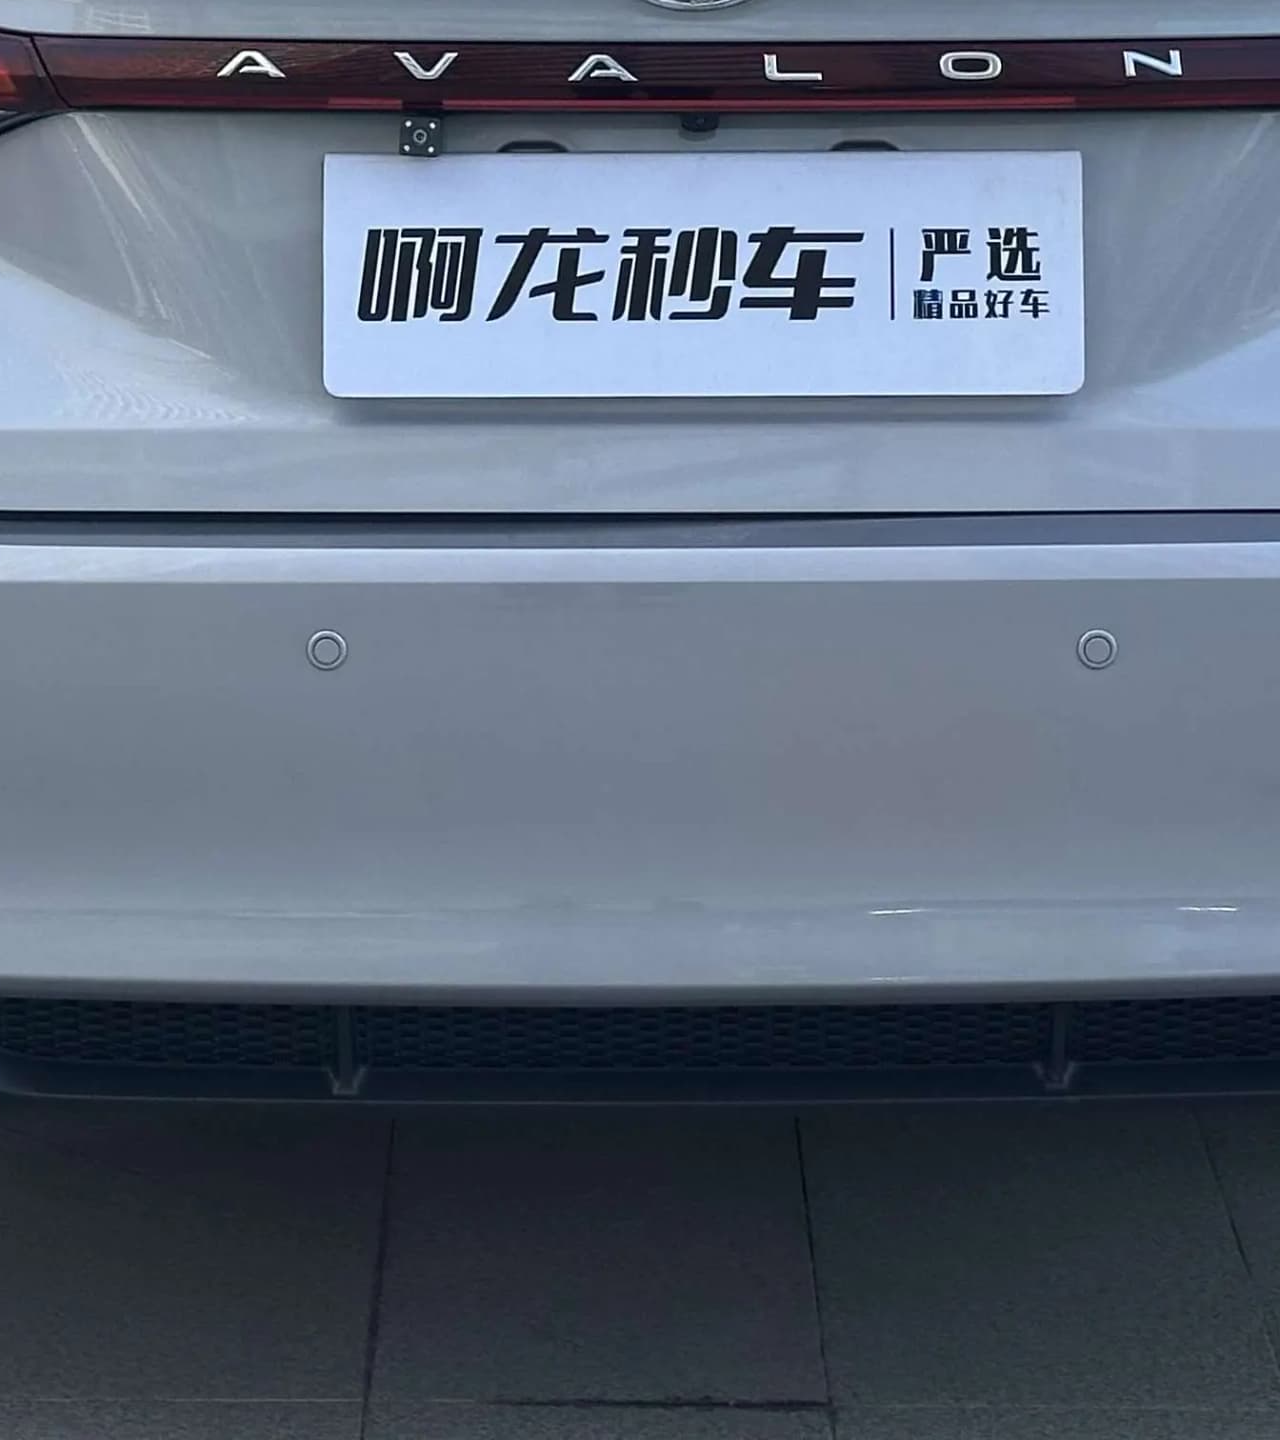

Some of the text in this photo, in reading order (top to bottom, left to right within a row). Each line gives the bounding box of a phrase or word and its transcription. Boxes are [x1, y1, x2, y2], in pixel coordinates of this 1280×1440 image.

[216, 49, 1182, 81] AVALON
[357, 227, 864, 321] 啊龙秒车
[920, 227, 1041, 281] 严选
[913, 289, 1050, 319] 精品好车
